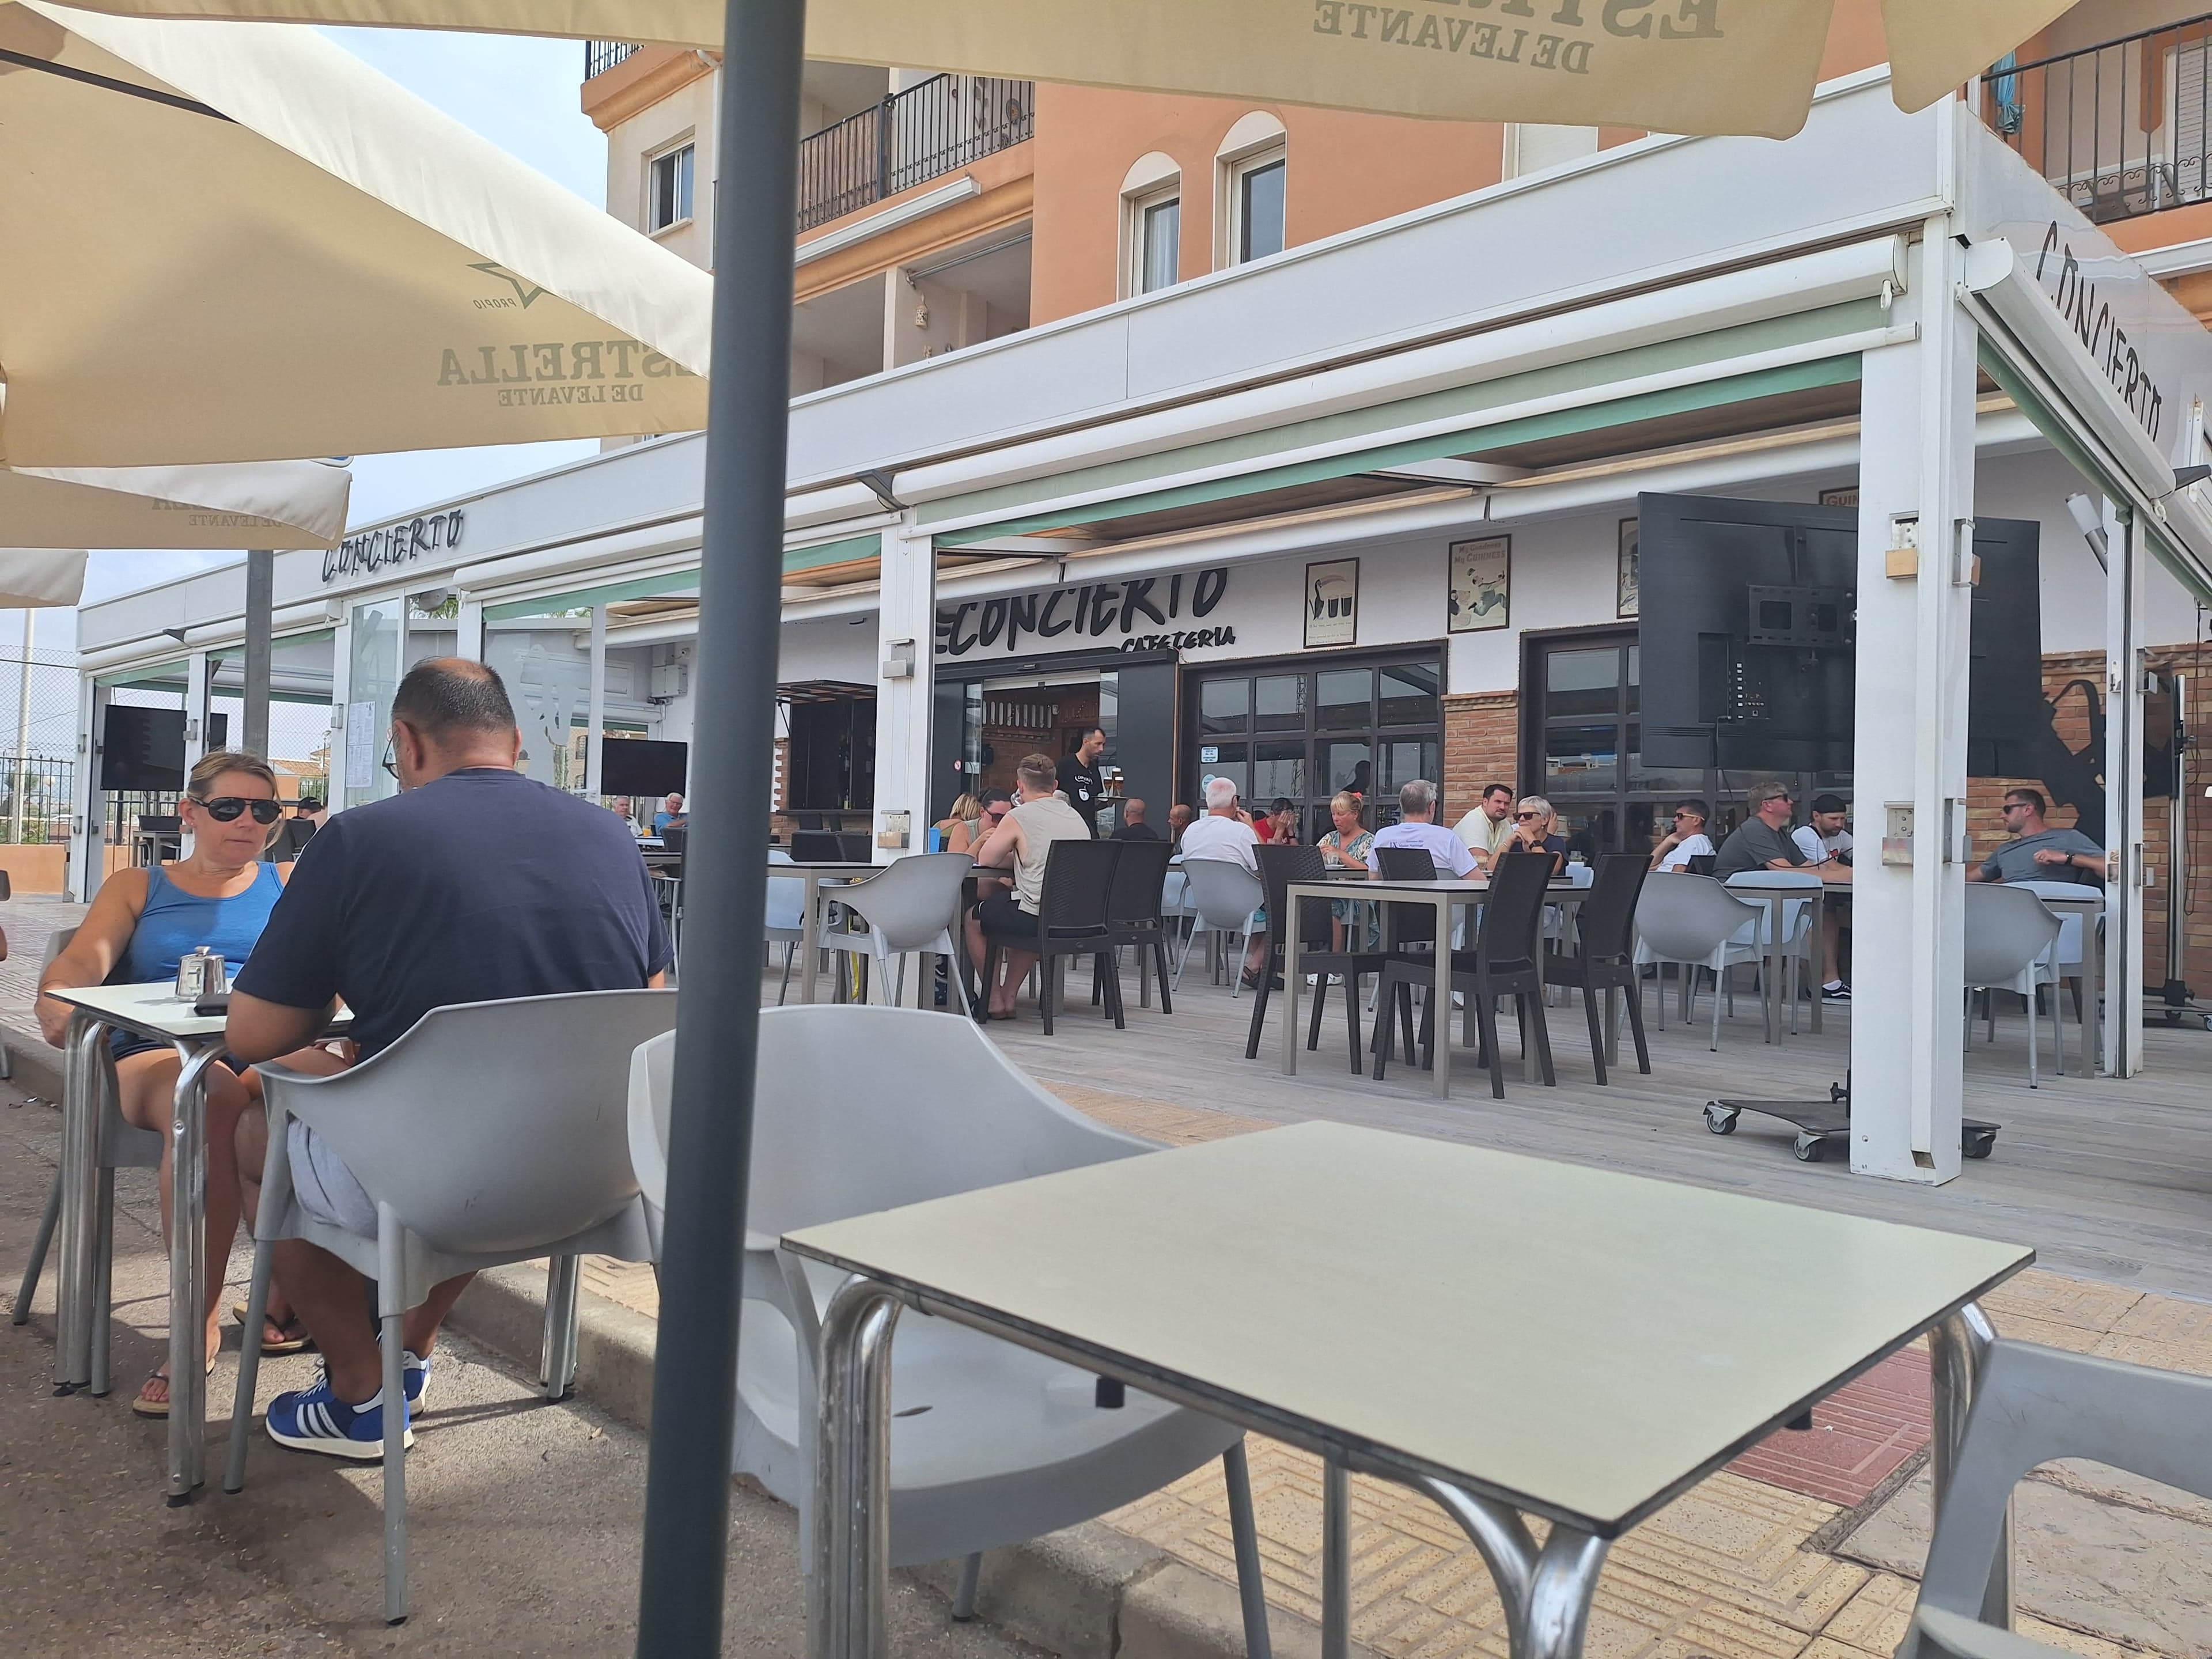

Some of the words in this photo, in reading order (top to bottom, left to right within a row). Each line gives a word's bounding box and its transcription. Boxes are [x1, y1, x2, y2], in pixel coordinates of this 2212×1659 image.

[2036, 220, 2162, 442] CONCIERTO
[322, 509, 463, 582] CONCIERTO
[1121, 626, 1236, 653] CAFETERIA
